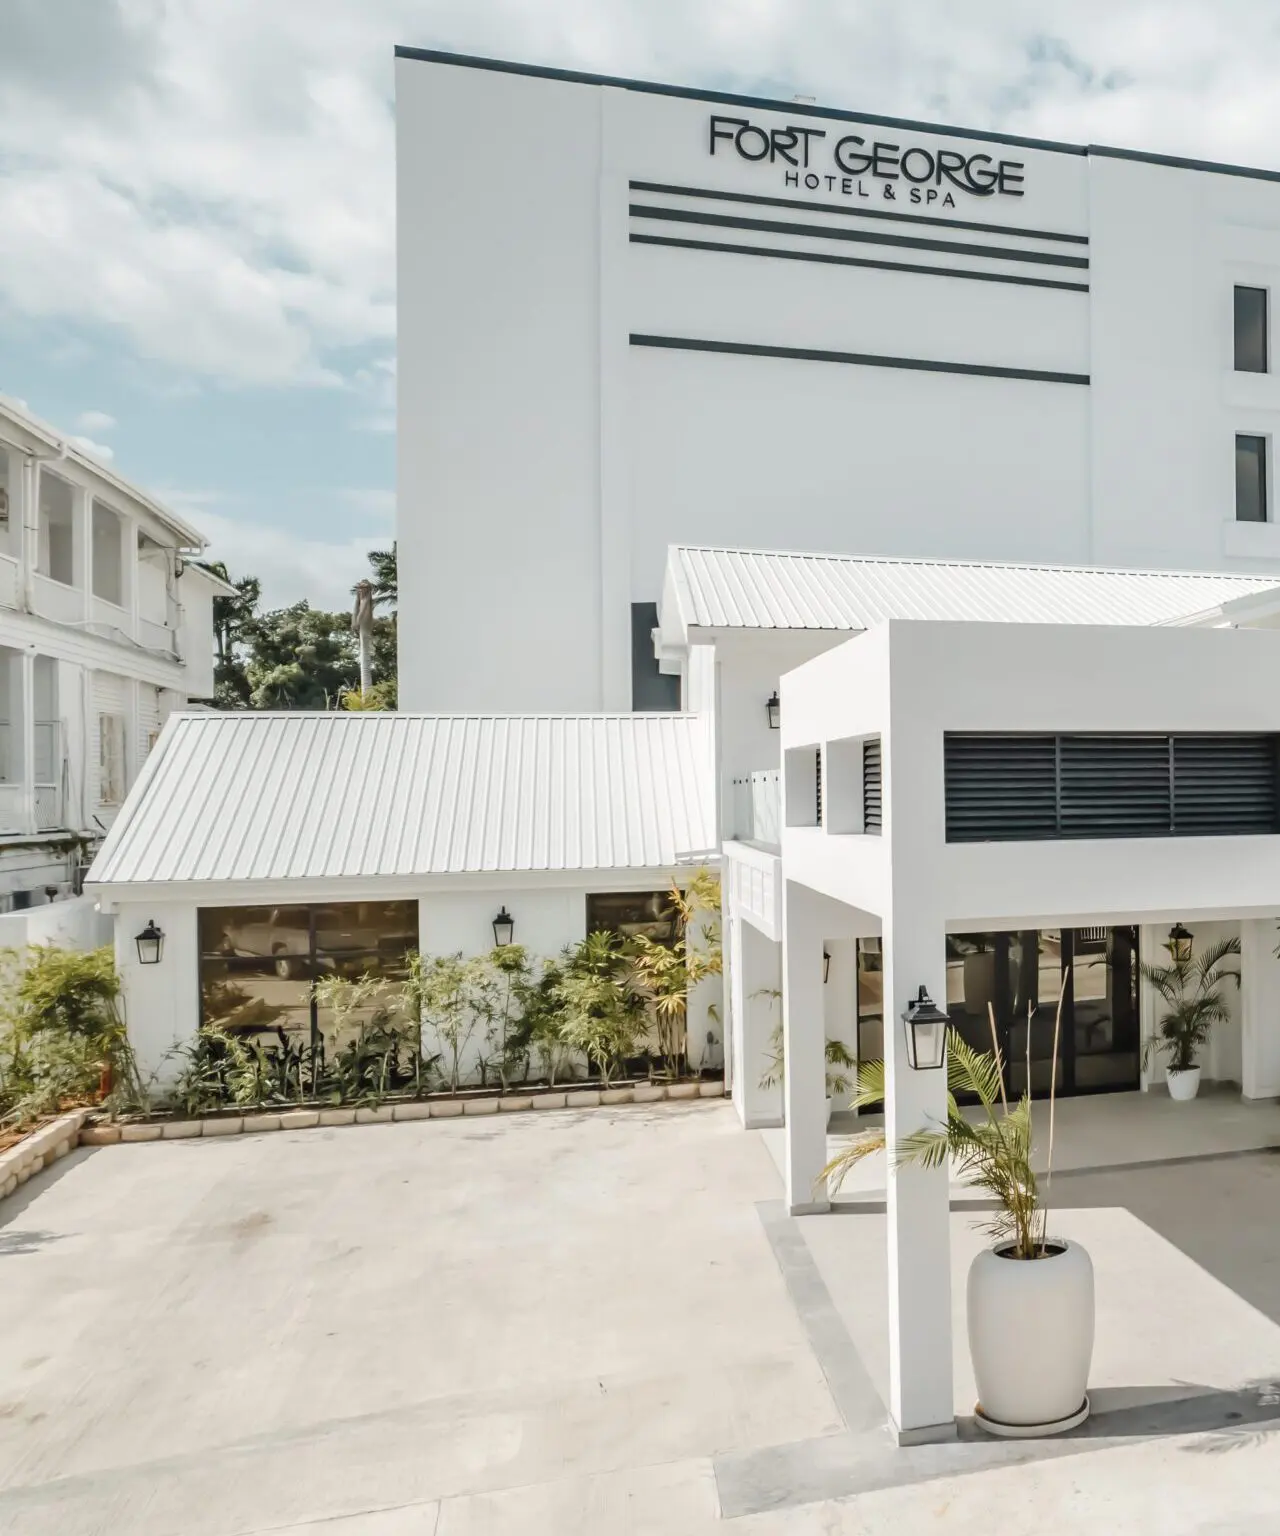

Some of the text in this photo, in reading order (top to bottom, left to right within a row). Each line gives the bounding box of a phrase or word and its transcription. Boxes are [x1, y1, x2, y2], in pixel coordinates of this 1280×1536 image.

[710, 115, 1025, 196] FORT GEORGE
[785, 171, 956, 208] HOTEL & SPA
